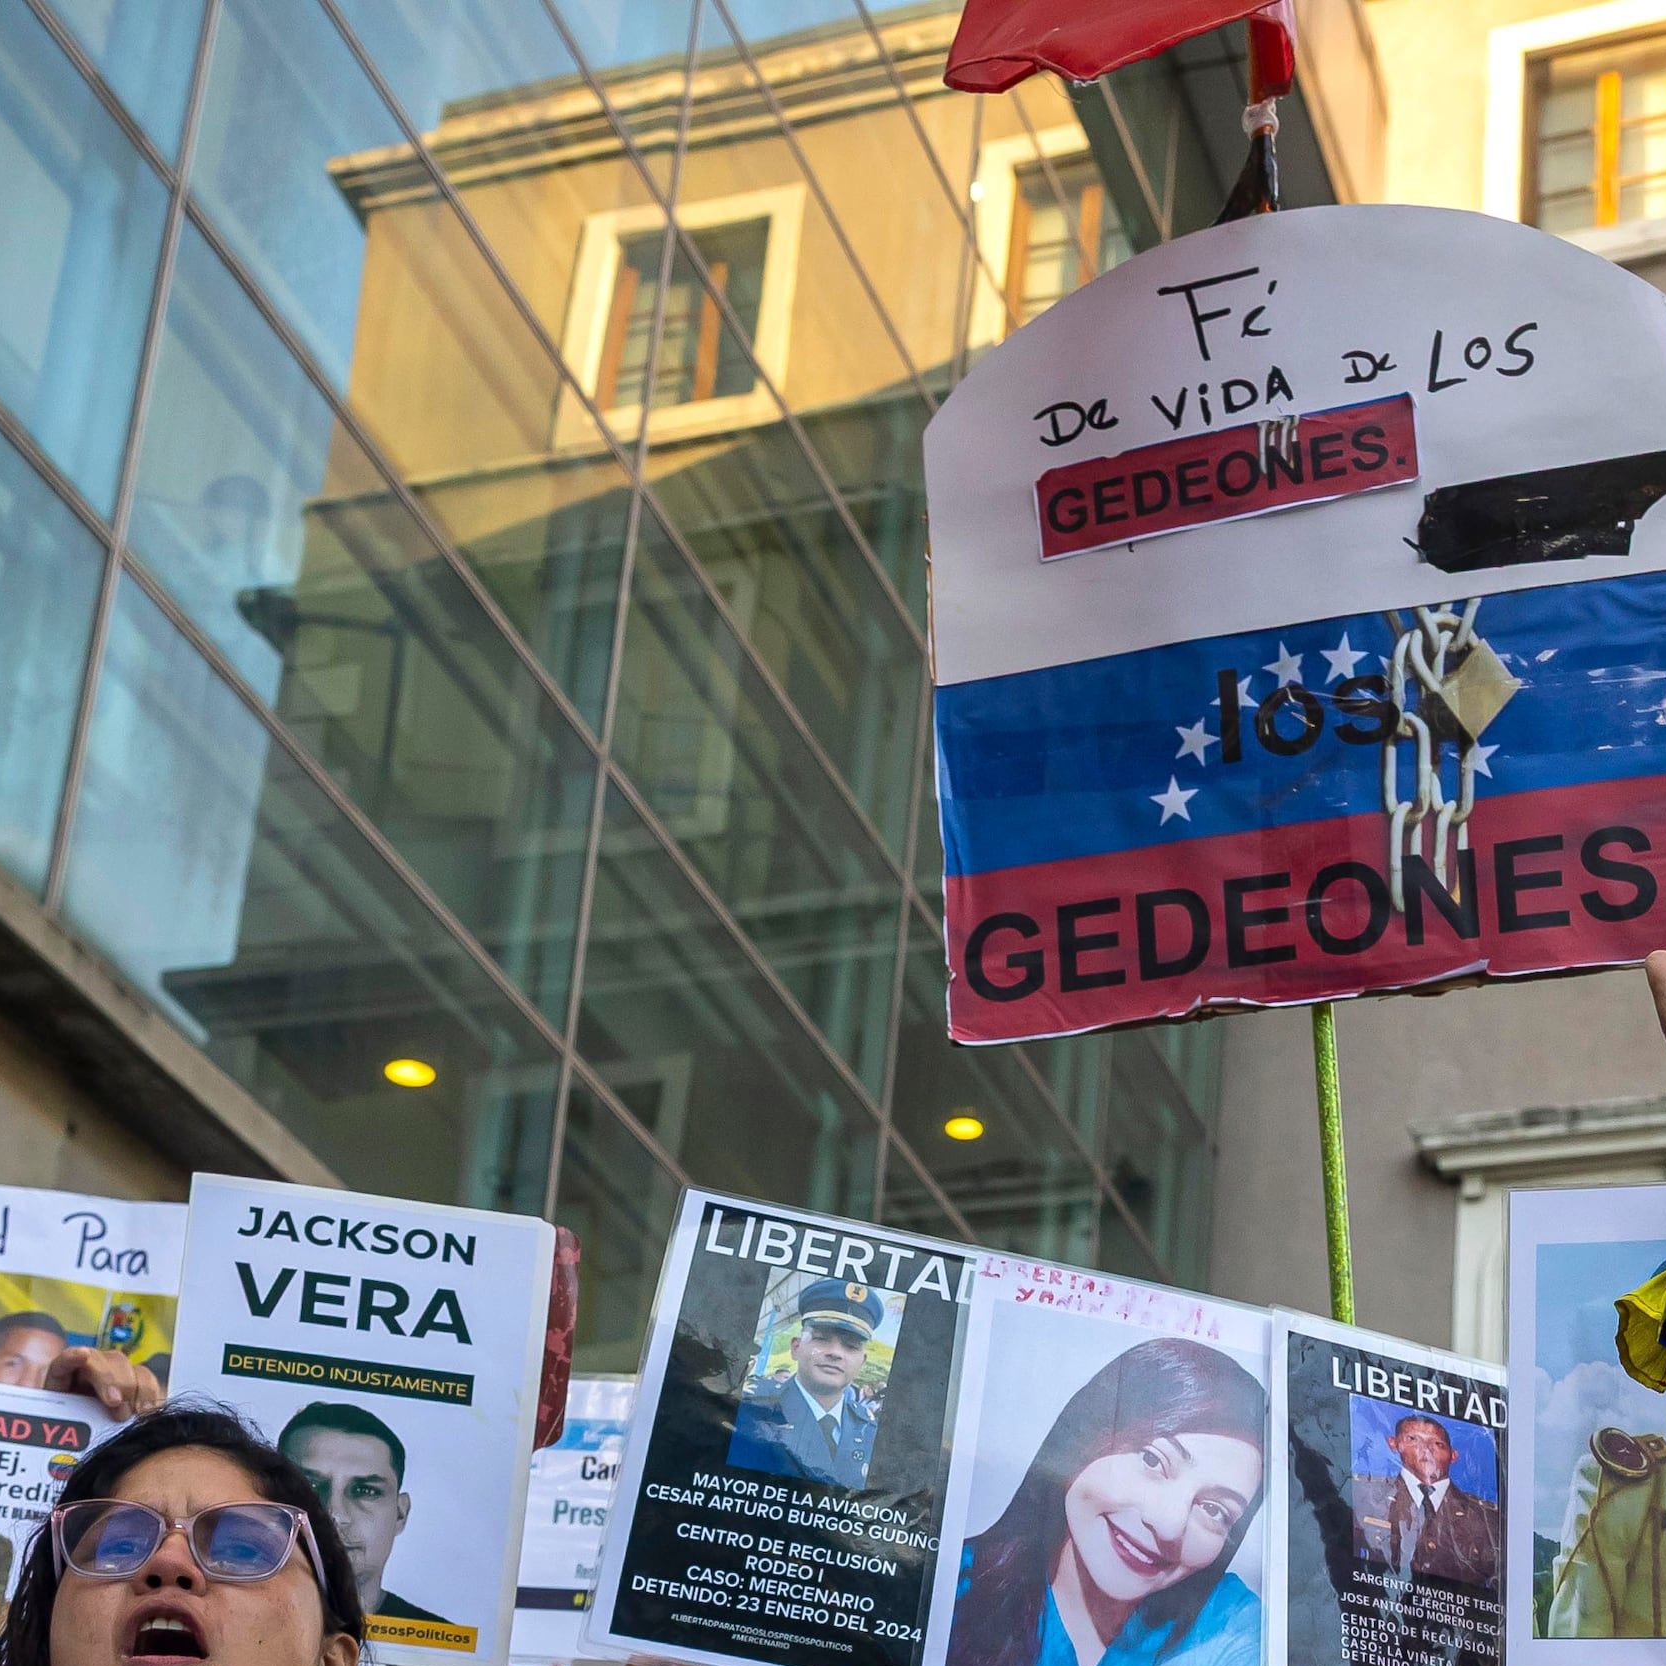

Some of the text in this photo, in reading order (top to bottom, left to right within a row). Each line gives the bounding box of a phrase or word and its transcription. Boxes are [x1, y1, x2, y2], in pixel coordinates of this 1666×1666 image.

[1426, 322, 1541, 394] LOS
[1046, 425, 1408, 535] GEDEONES.
[1216, 667, 1401, 764] los
[63, 1211, 149, 1277] Para
[236, 1206, 477, 1266] JACKSON
[234, 1261, 473, 1345] VERA
[228, 1353, 469, 1398] DETENIDO INJUSTAMENTE
[1331, 1356, 1508, 1430] LIBERTAD
[41, 1423, 80, 1448] YA
[646, 1483, 864, 1538] CESAR ARTURO BURGOS
[692, 1472, 908, 1526] MAYOR AVIACION
[676, 1522, 898, 1577] CENTRO RECLUSIÓN
[745, 1555, 814, 1581] RODEO
[632, 1575, 923, 1643] DETENIDO: 23 ENERO DEL 2024
[686, 1564, 875, 1613] CASO: MERCENARIO
[1352, 1570, 1455, 1603] SARGENTO MAYOR
[1340, 1612, 1396, 1634] CENTRO
[1341, 1624, 1389, 1644] RODEO
[1372, 1598, 1475, 1631] ANTONIO MORENO
